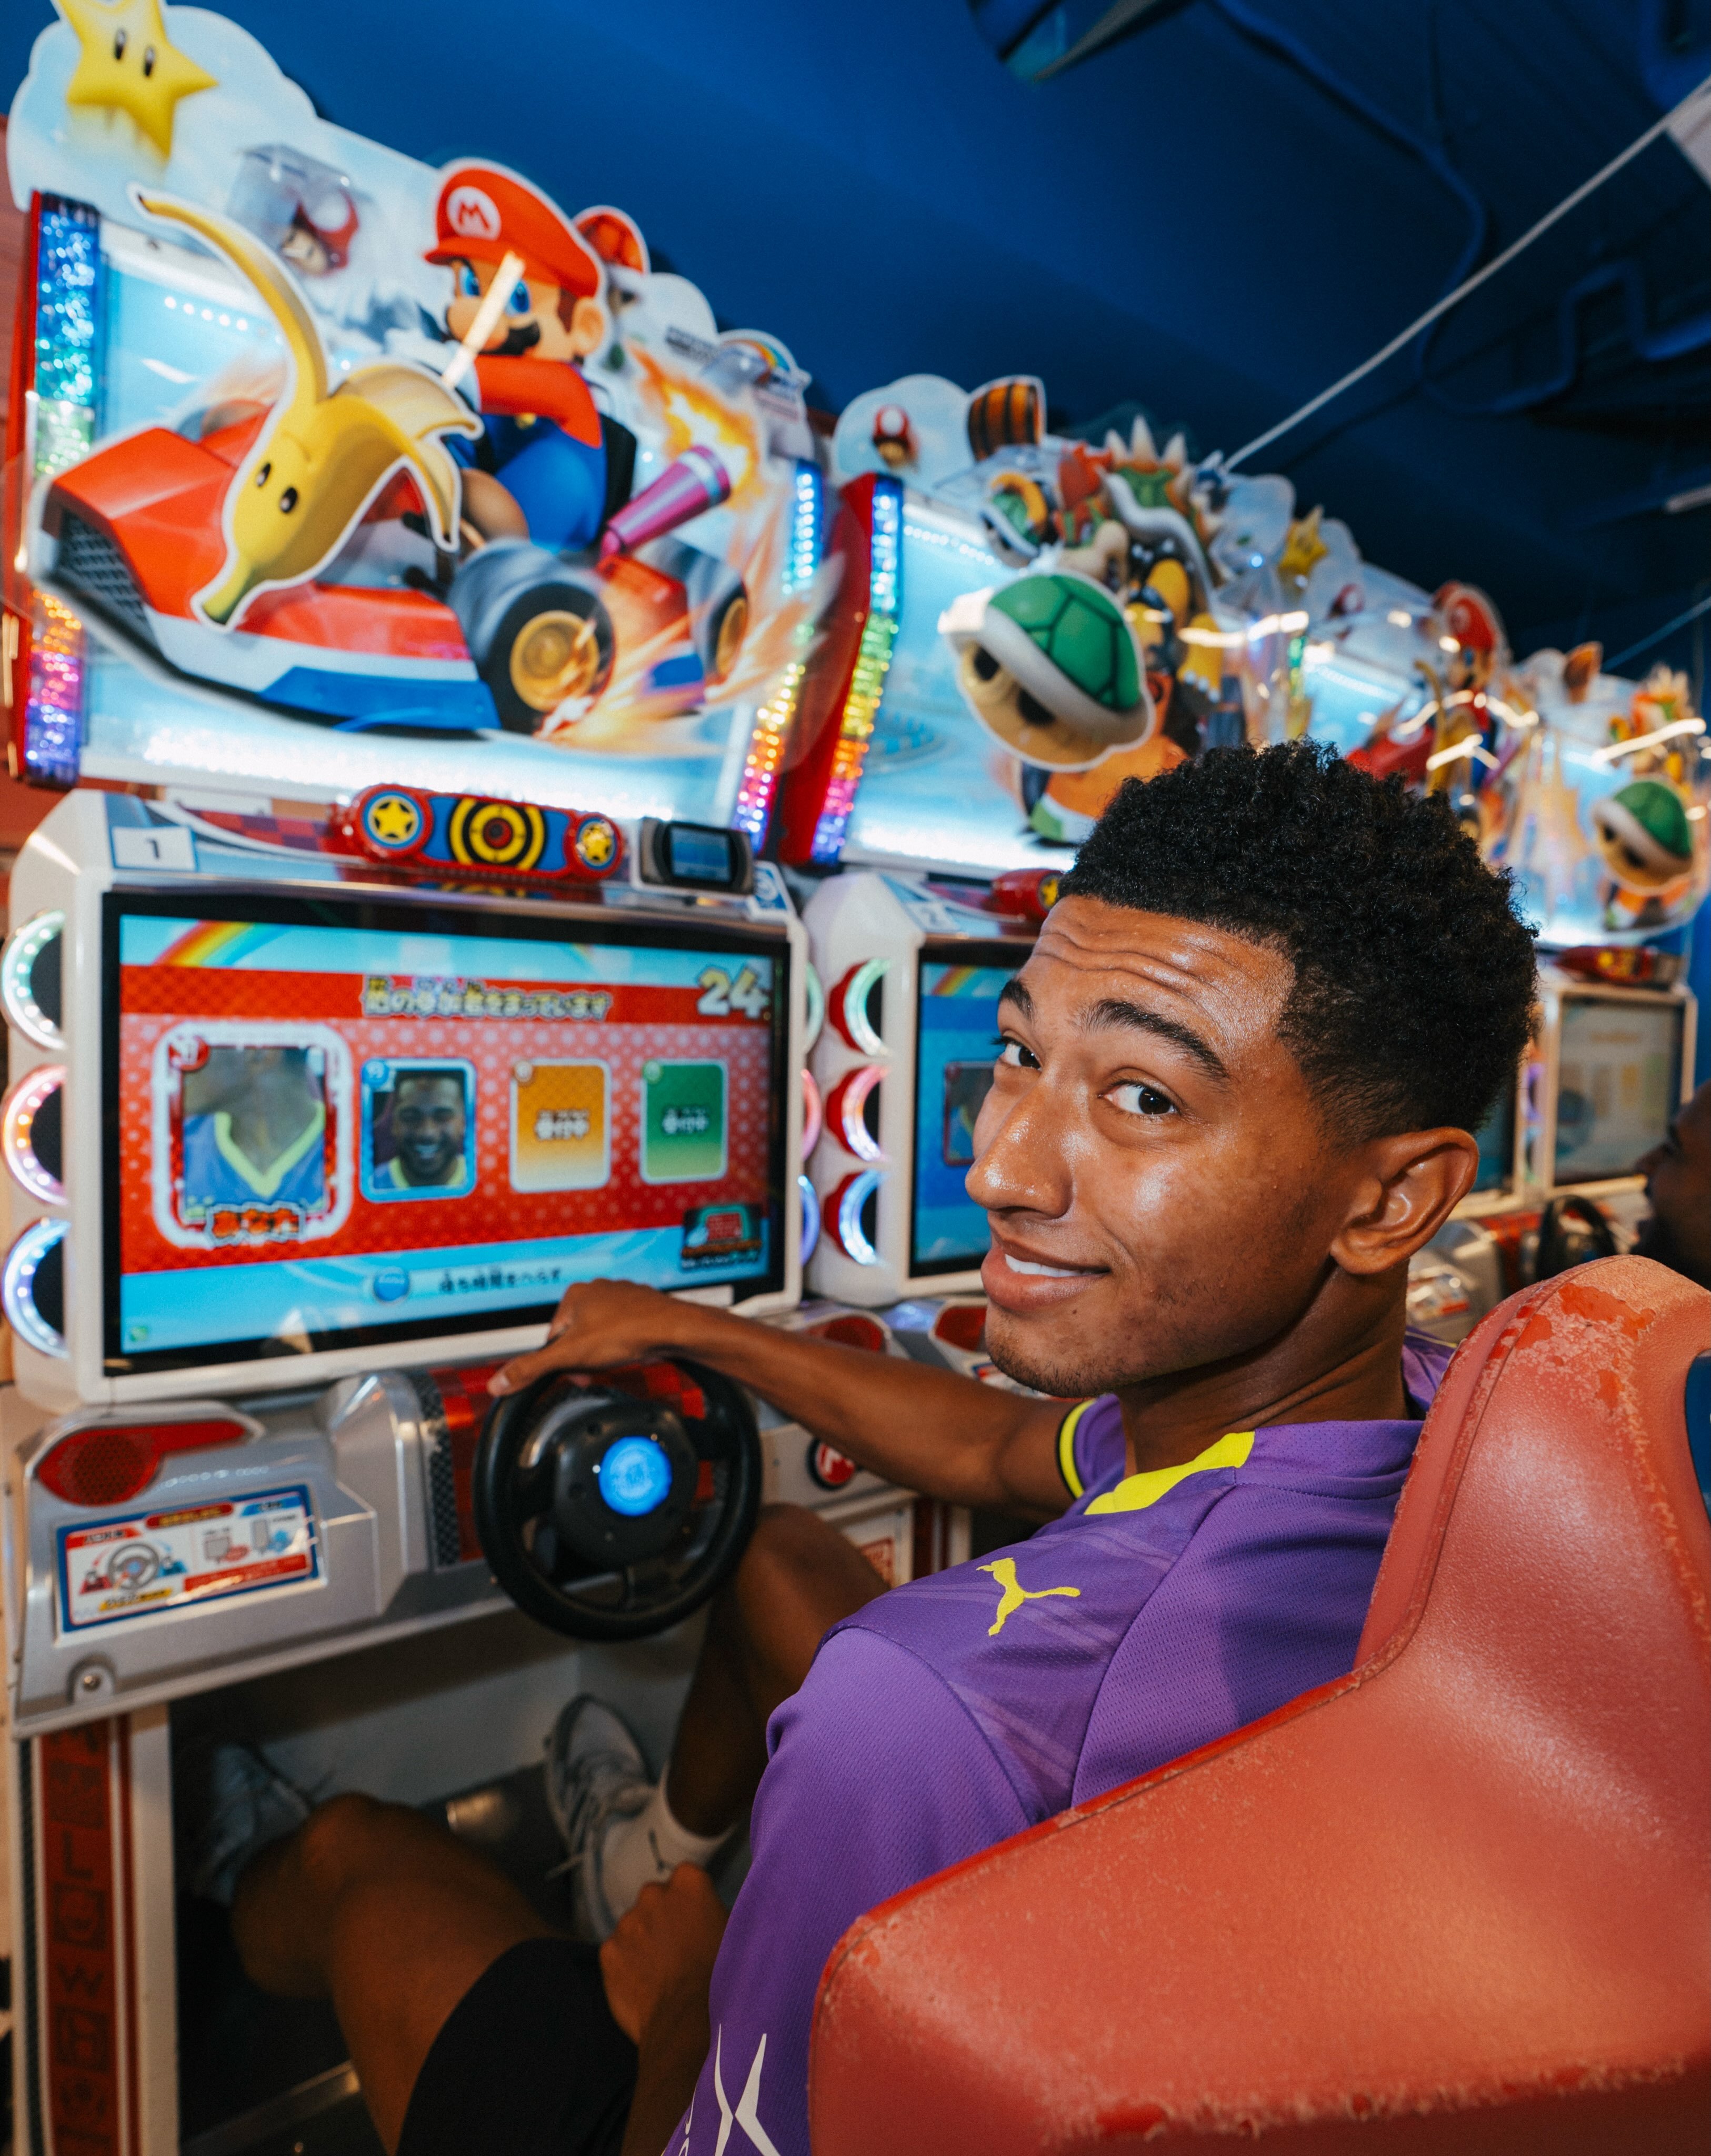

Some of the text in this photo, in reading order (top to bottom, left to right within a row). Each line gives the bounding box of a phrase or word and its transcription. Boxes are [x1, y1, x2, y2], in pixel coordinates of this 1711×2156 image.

[457, 202, 490, 231] M
[145, 837, 161, 860] 1
[697, 966, 771, 1020] 24
